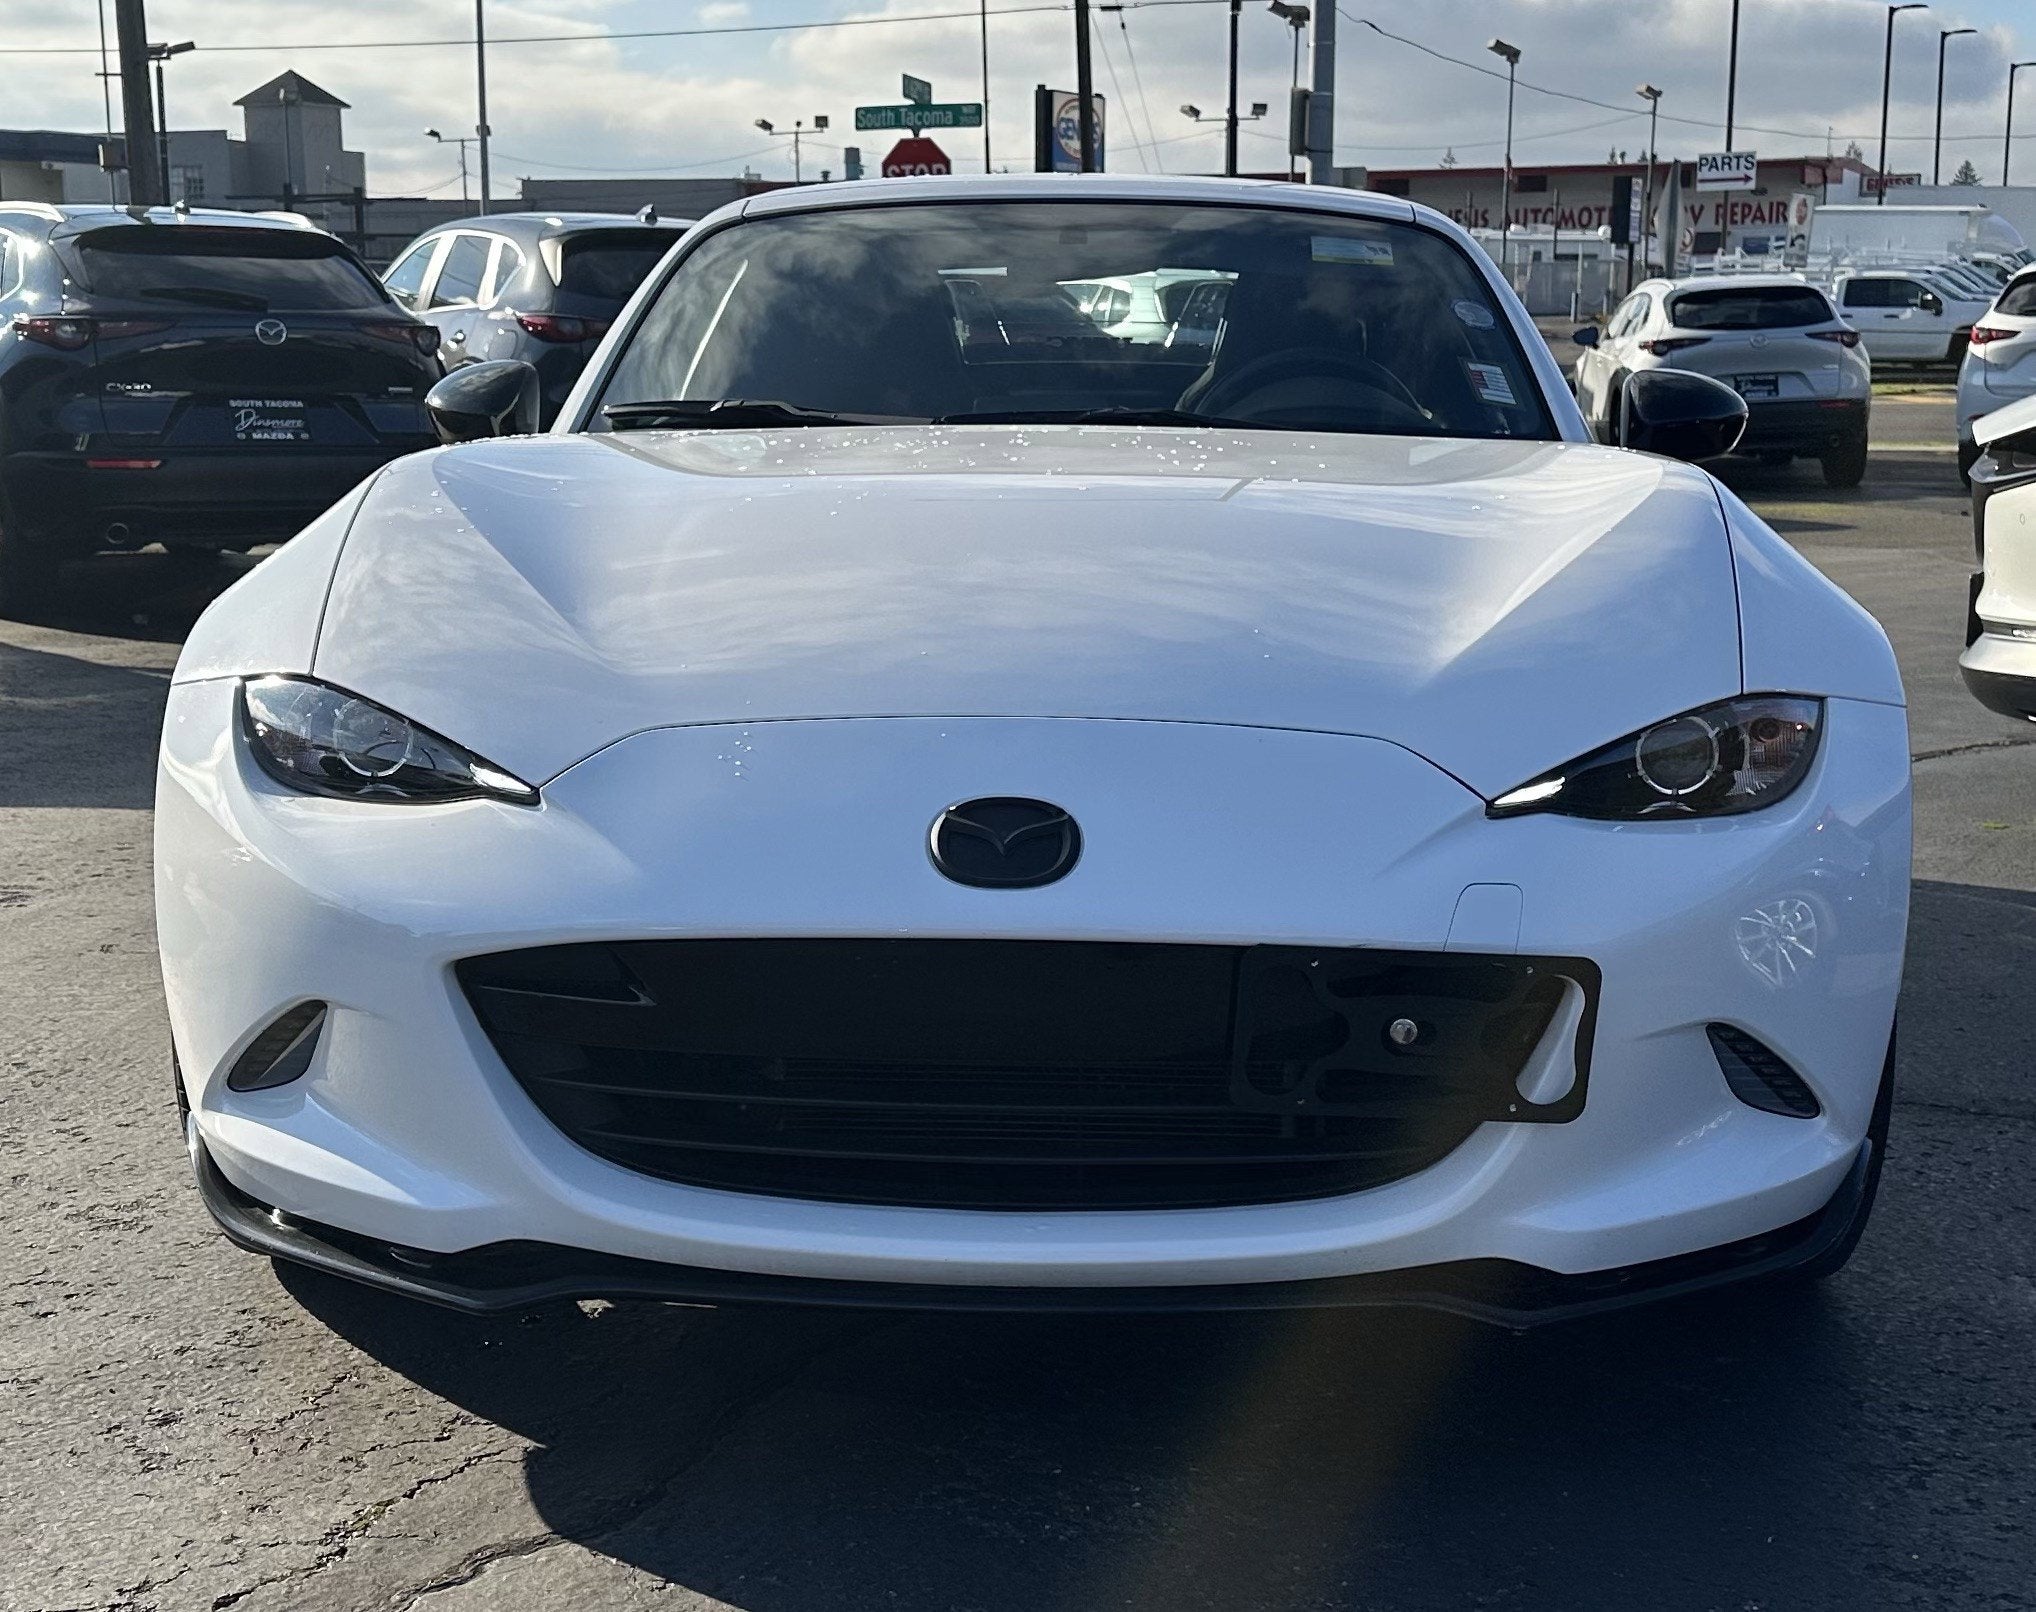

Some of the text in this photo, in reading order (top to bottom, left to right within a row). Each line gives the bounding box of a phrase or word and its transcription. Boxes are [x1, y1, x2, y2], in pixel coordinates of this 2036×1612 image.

[857, 109, 895, 127] South
[899, 107, 954, 126] Tacoma
[1698, 154, 1755, 173] PARTS
[1714, 201, 1788, 226] REPAIR
[252, 432, 295, 440] MAZDA
